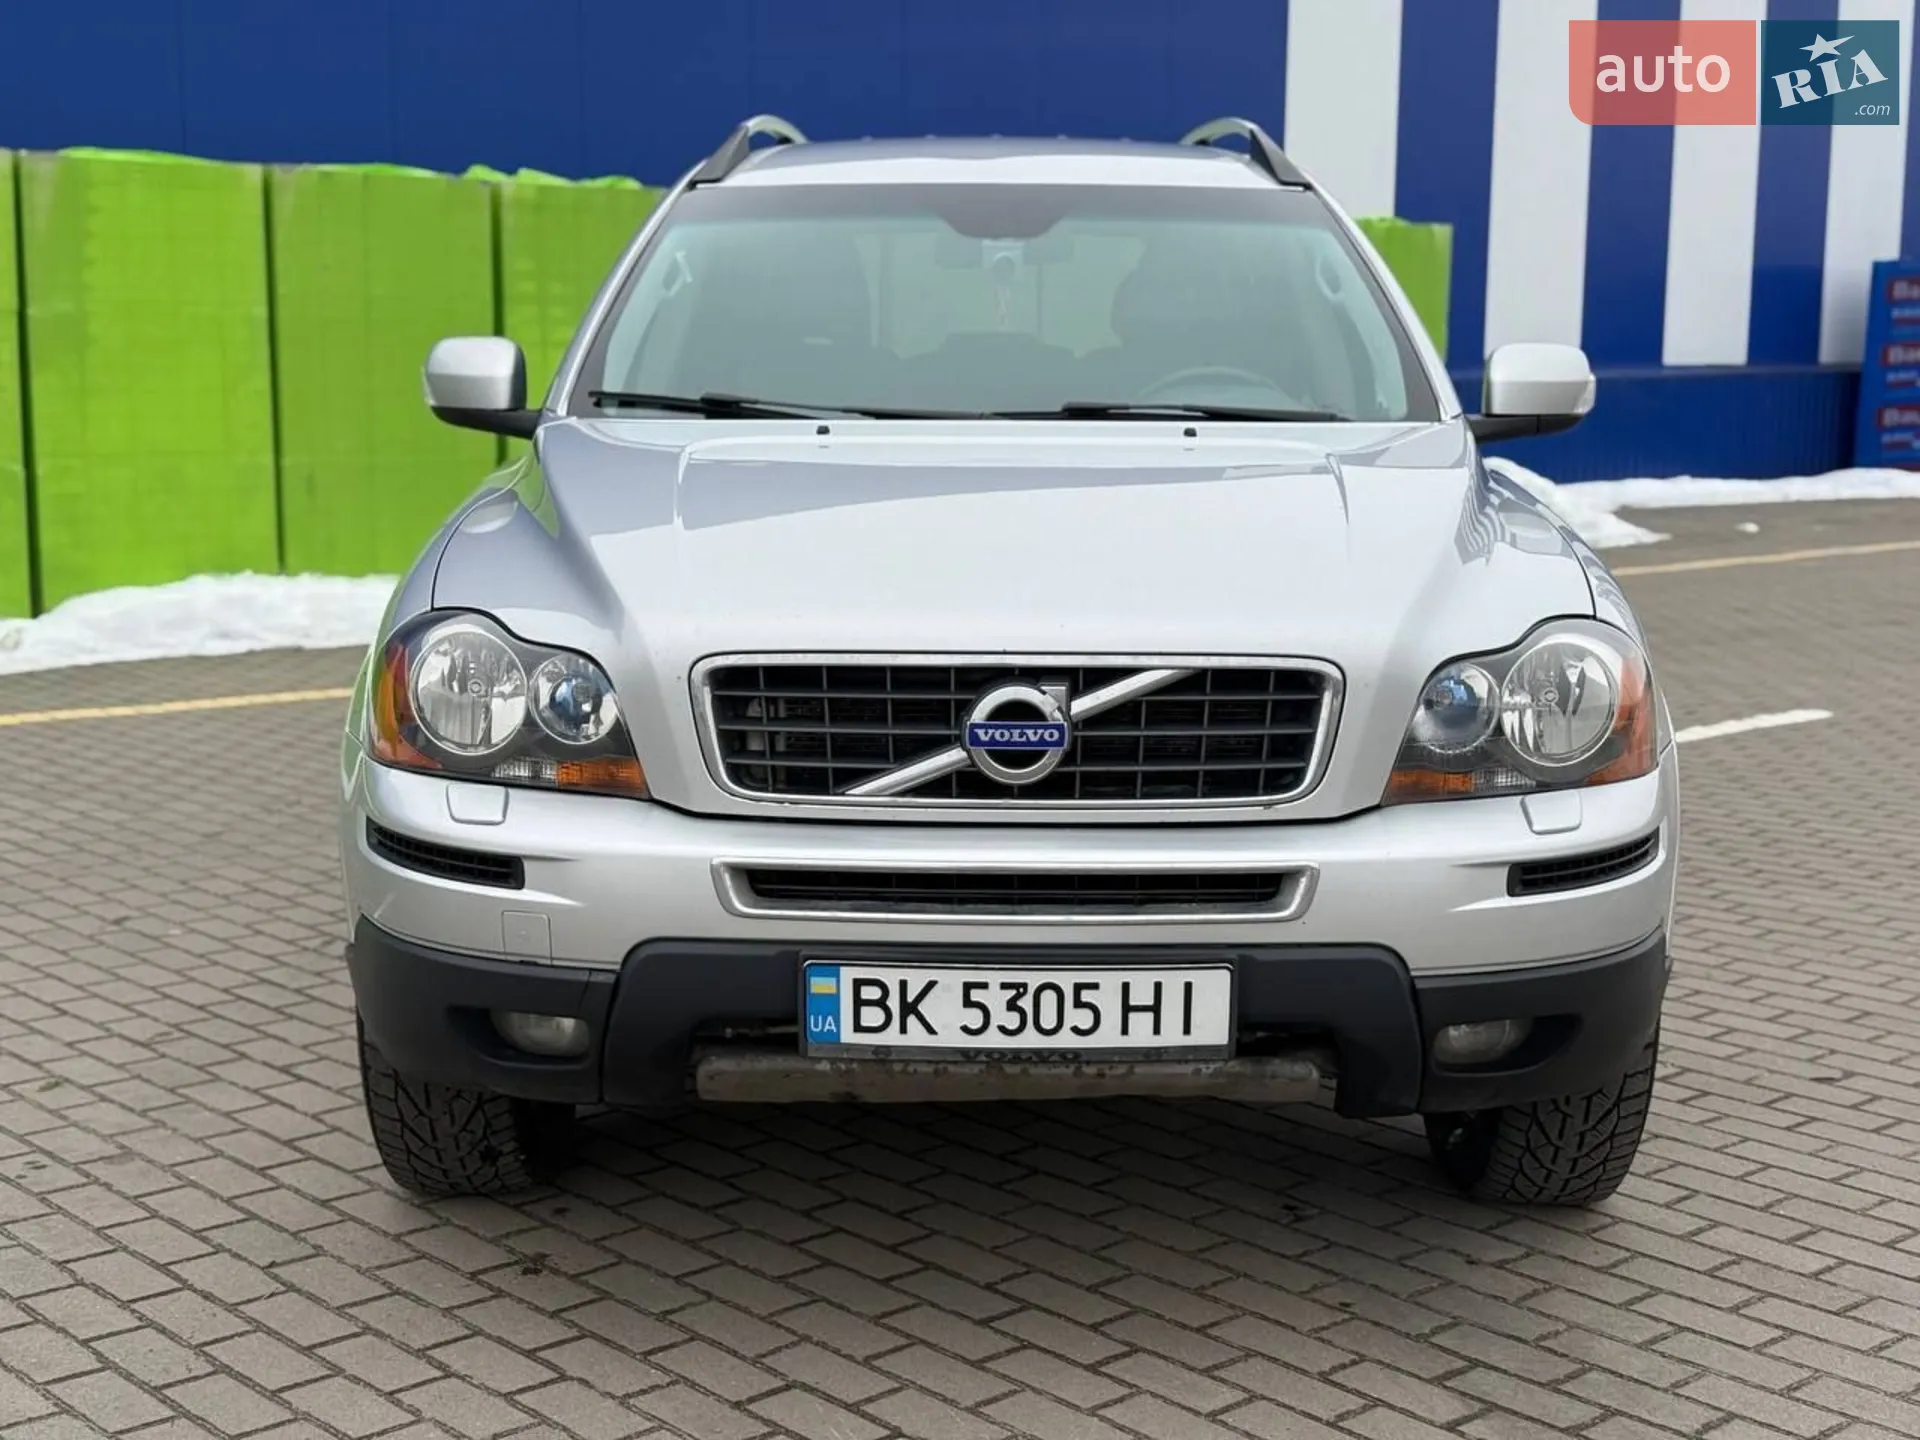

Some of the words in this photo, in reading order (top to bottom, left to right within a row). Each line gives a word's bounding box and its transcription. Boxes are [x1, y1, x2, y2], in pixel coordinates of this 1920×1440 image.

[973, 728, 1060, 742] VOLVO
[852, 977, 939, 1036] BK
[959, 981, 1102, 1037] 5305
[1120, 980, 1194, 1037] HI
[810, 1015, 837, 1033] UA
